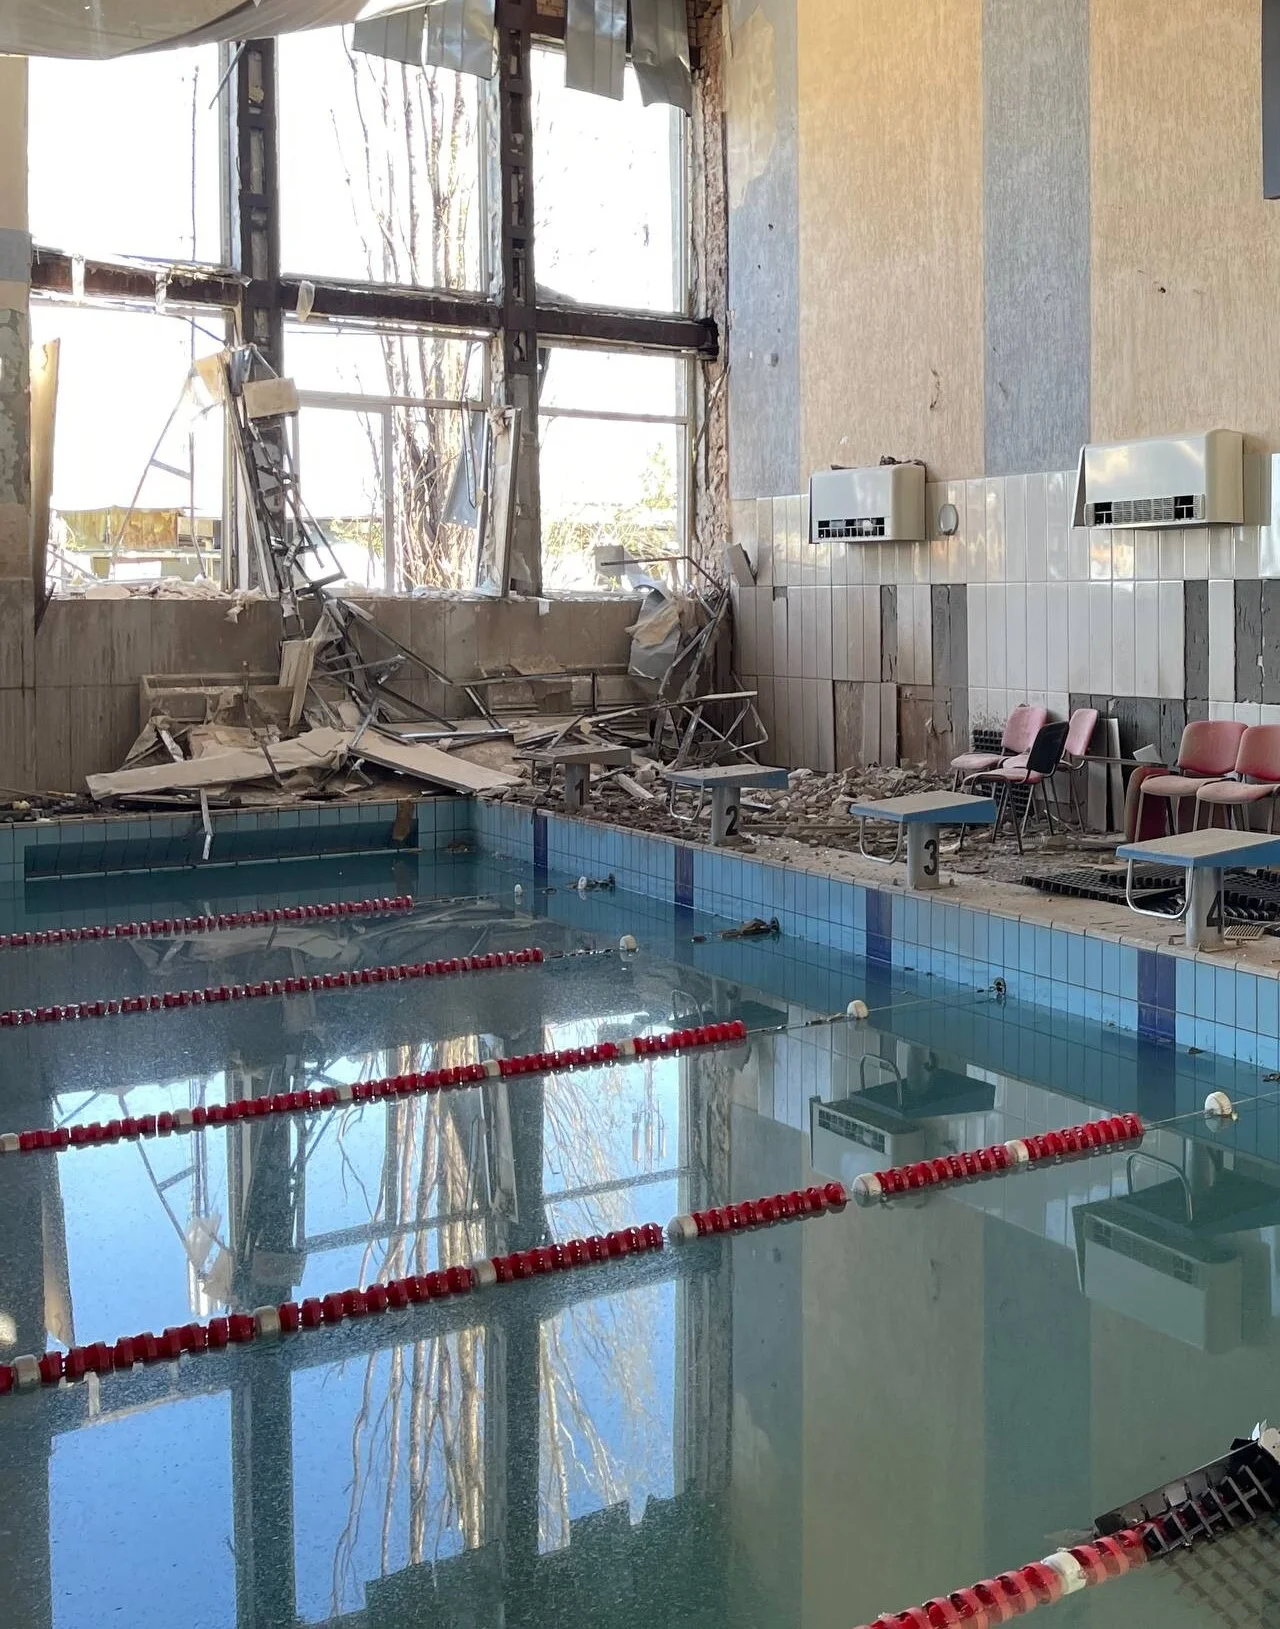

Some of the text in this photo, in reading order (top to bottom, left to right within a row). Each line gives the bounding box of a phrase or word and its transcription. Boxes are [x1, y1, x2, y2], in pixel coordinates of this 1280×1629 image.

[574, 779, 584, 806] 1
[725, 805, 738, 836] 2
[923, 839, 938, 876] 3
[1206, 890, 1223, 934] 4
